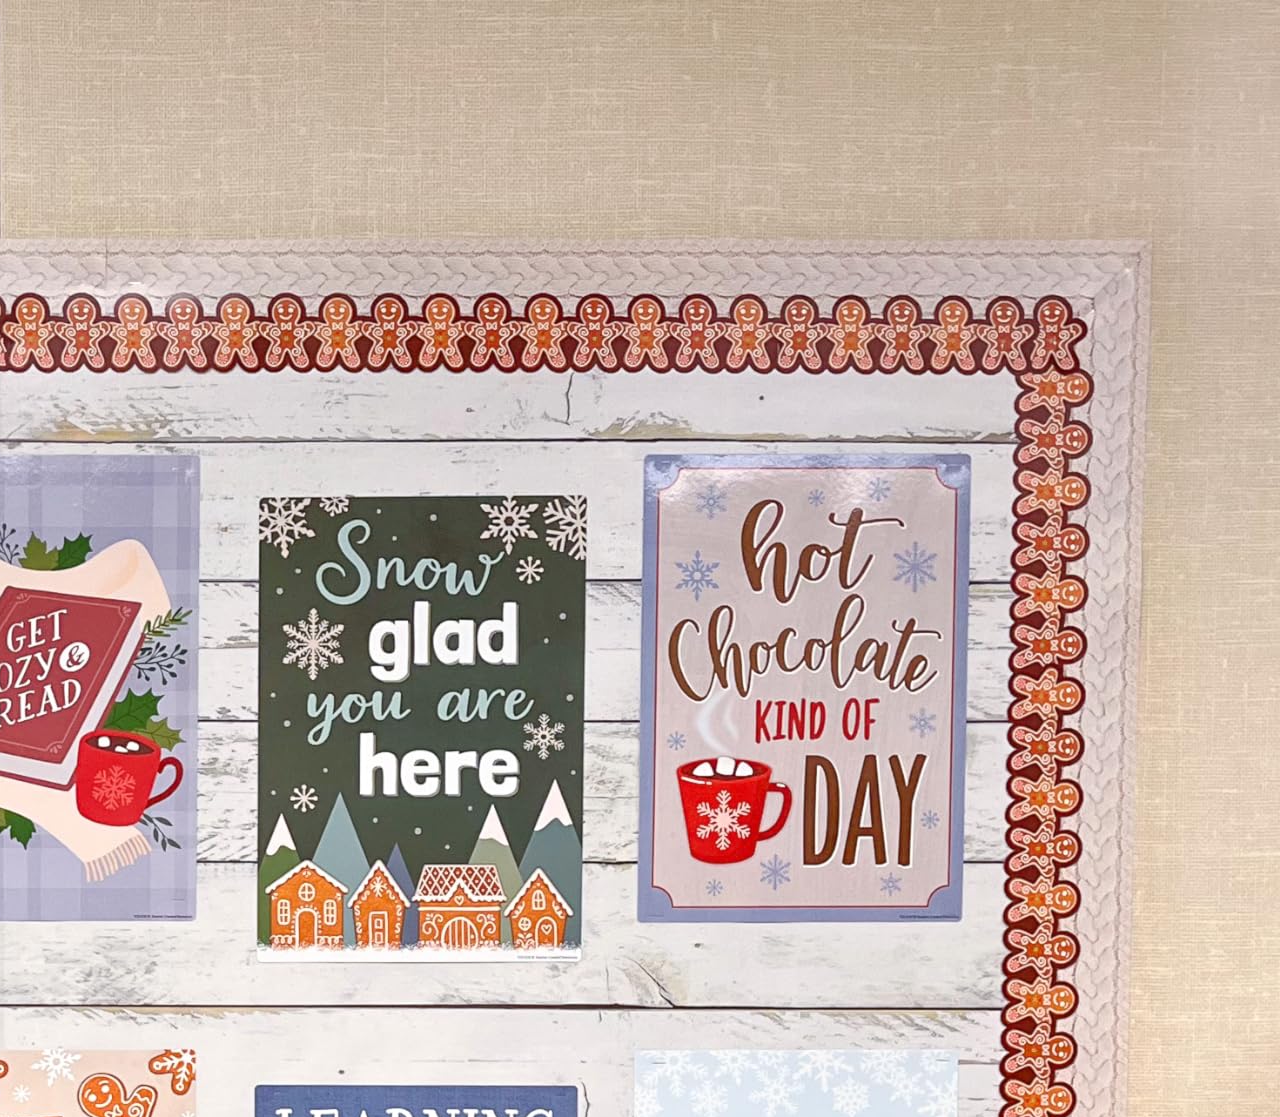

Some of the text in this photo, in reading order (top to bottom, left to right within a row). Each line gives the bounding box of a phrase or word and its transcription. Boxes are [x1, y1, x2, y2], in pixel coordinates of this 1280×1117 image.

[315, 519, 504, 606] Snow
[740, 499, 906, 606] hot
[5, 607, 68, 655] GET
[368, 600, 519, 684] glad
[668, 593, 943, 703] Chocolate
[306, 690, 536, 746] you are
[754, 698, 880, 744] KIND OF
[358, 731, 520, 799] here
[802, 754, 927, 868] DAY
